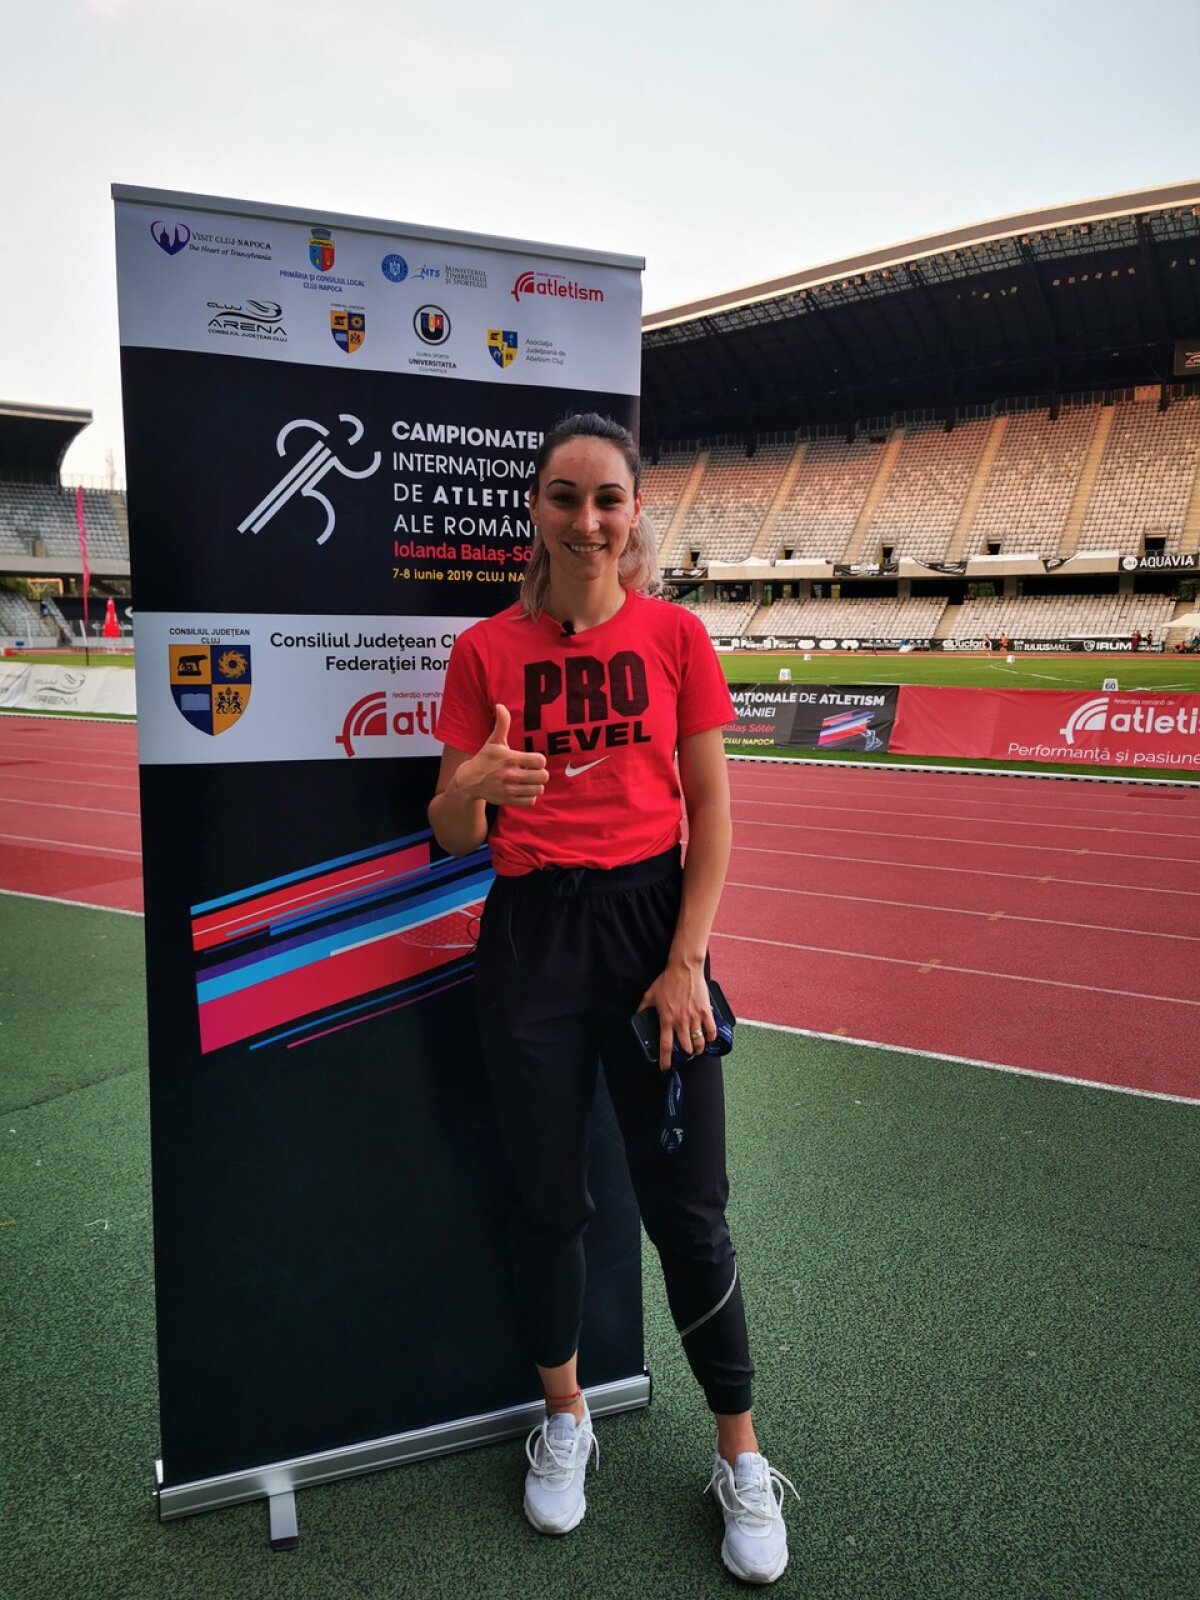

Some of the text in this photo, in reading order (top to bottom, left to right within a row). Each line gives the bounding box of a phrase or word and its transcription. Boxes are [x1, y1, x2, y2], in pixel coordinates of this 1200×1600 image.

[192, 232, 271, 251] VISIT CLUJ-NAPOCA
[201, 245, 220, 256] Heart
[347, 279, 366, 288] LOCAL
[536, 278, 603, 303] atletism
[207, 302, 242, 311] CLUJ
[208, 318, 286, 336] ARENA
[408, 357, 457, 370] UNIVERSITATEA
[393, 483, 423, 504] DE
[393, 514, 434, 534] ALE
[393, 540, 457, 562] Iolanda
[1139, 555, 1195, 568] AQUAVIA
[392, 568, 411, 581] 7-8
[414, 569, 444, 582] iunie
[447, 570, 472, 583] 2019
[476, 571, 505, 583] CLUJ
[169, 628, 209, 636] CONSILIUL
[200, 637, 221, 645] CLUJ
[269, 632, 351, 648] Consiliul
[1096, 640, 1132, 651] IRUM
[523, 650, 650, 732] PRO
[1104, 682, 1116, 691] 60
[799, 694, 817, 705] DE
[819, 694, 886, 707] ATLETISM
[1110, 706, 1200, 735] atleti
